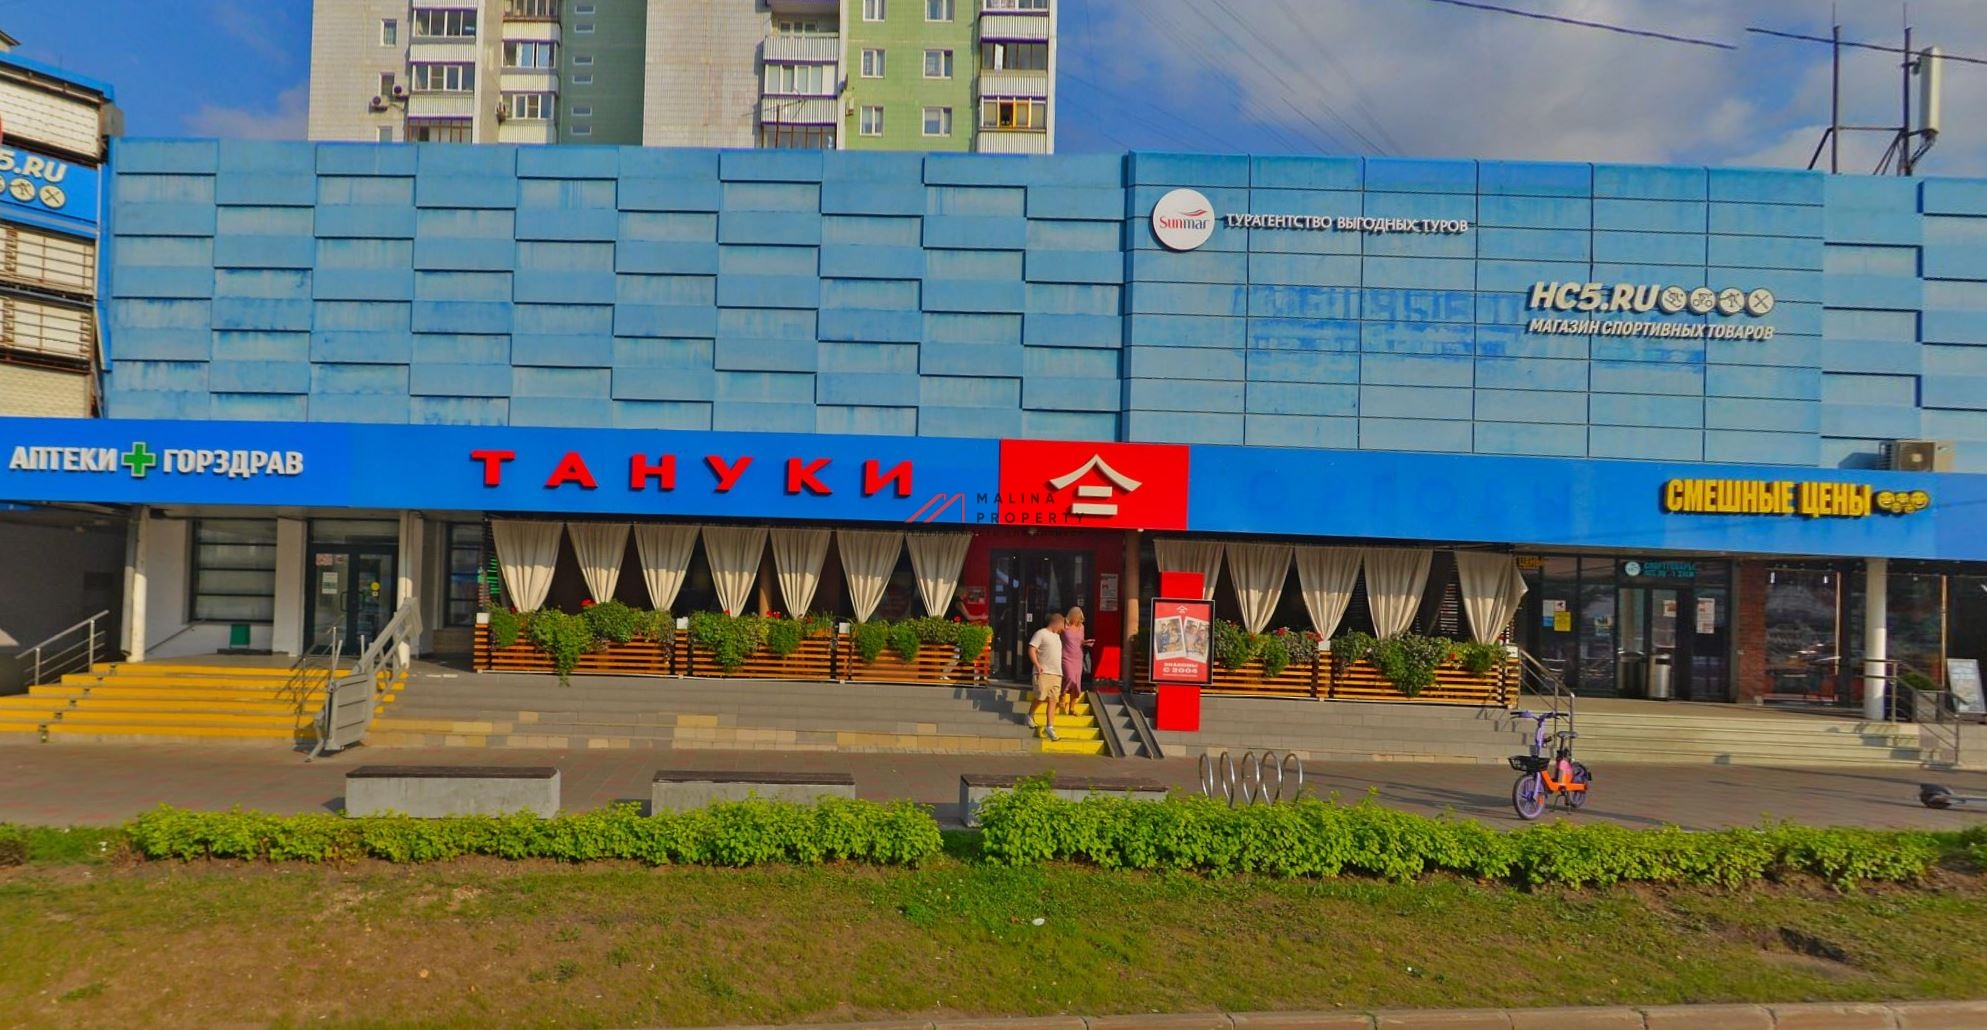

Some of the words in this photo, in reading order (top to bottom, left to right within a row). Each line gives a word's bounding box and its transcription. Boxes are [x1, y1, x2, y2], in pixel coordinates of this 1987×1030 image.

[1159, 216, 1208, 230] Sunmar
[1226, 213, 1332, 229] ТУРАГЕНТСТВО
[1336, 216, 1418, 233] ВЫГОДНЫХ
[1420, 218, 1468, 233] ТУРОВ
[1530, 281, 1661, 312] HC5.RU
[1529, 318, 1600, 335] МАГАЗИН
[1602, 320, 1706, 338] СПОРТИВНЫХ
[1707, 323, 1774, 340] ТОВАРОВ
[9, 446, 118, 472] АПТЕКИ
[163, 448, 304, 478] ГОРЗДРАВ
[470, 449, 913, 497] ТАНУКИ
[1666, 478, 1795, 514] СМЕШНЫЕ
[1799, 481, 1872, 518] ЦЕНЫ
